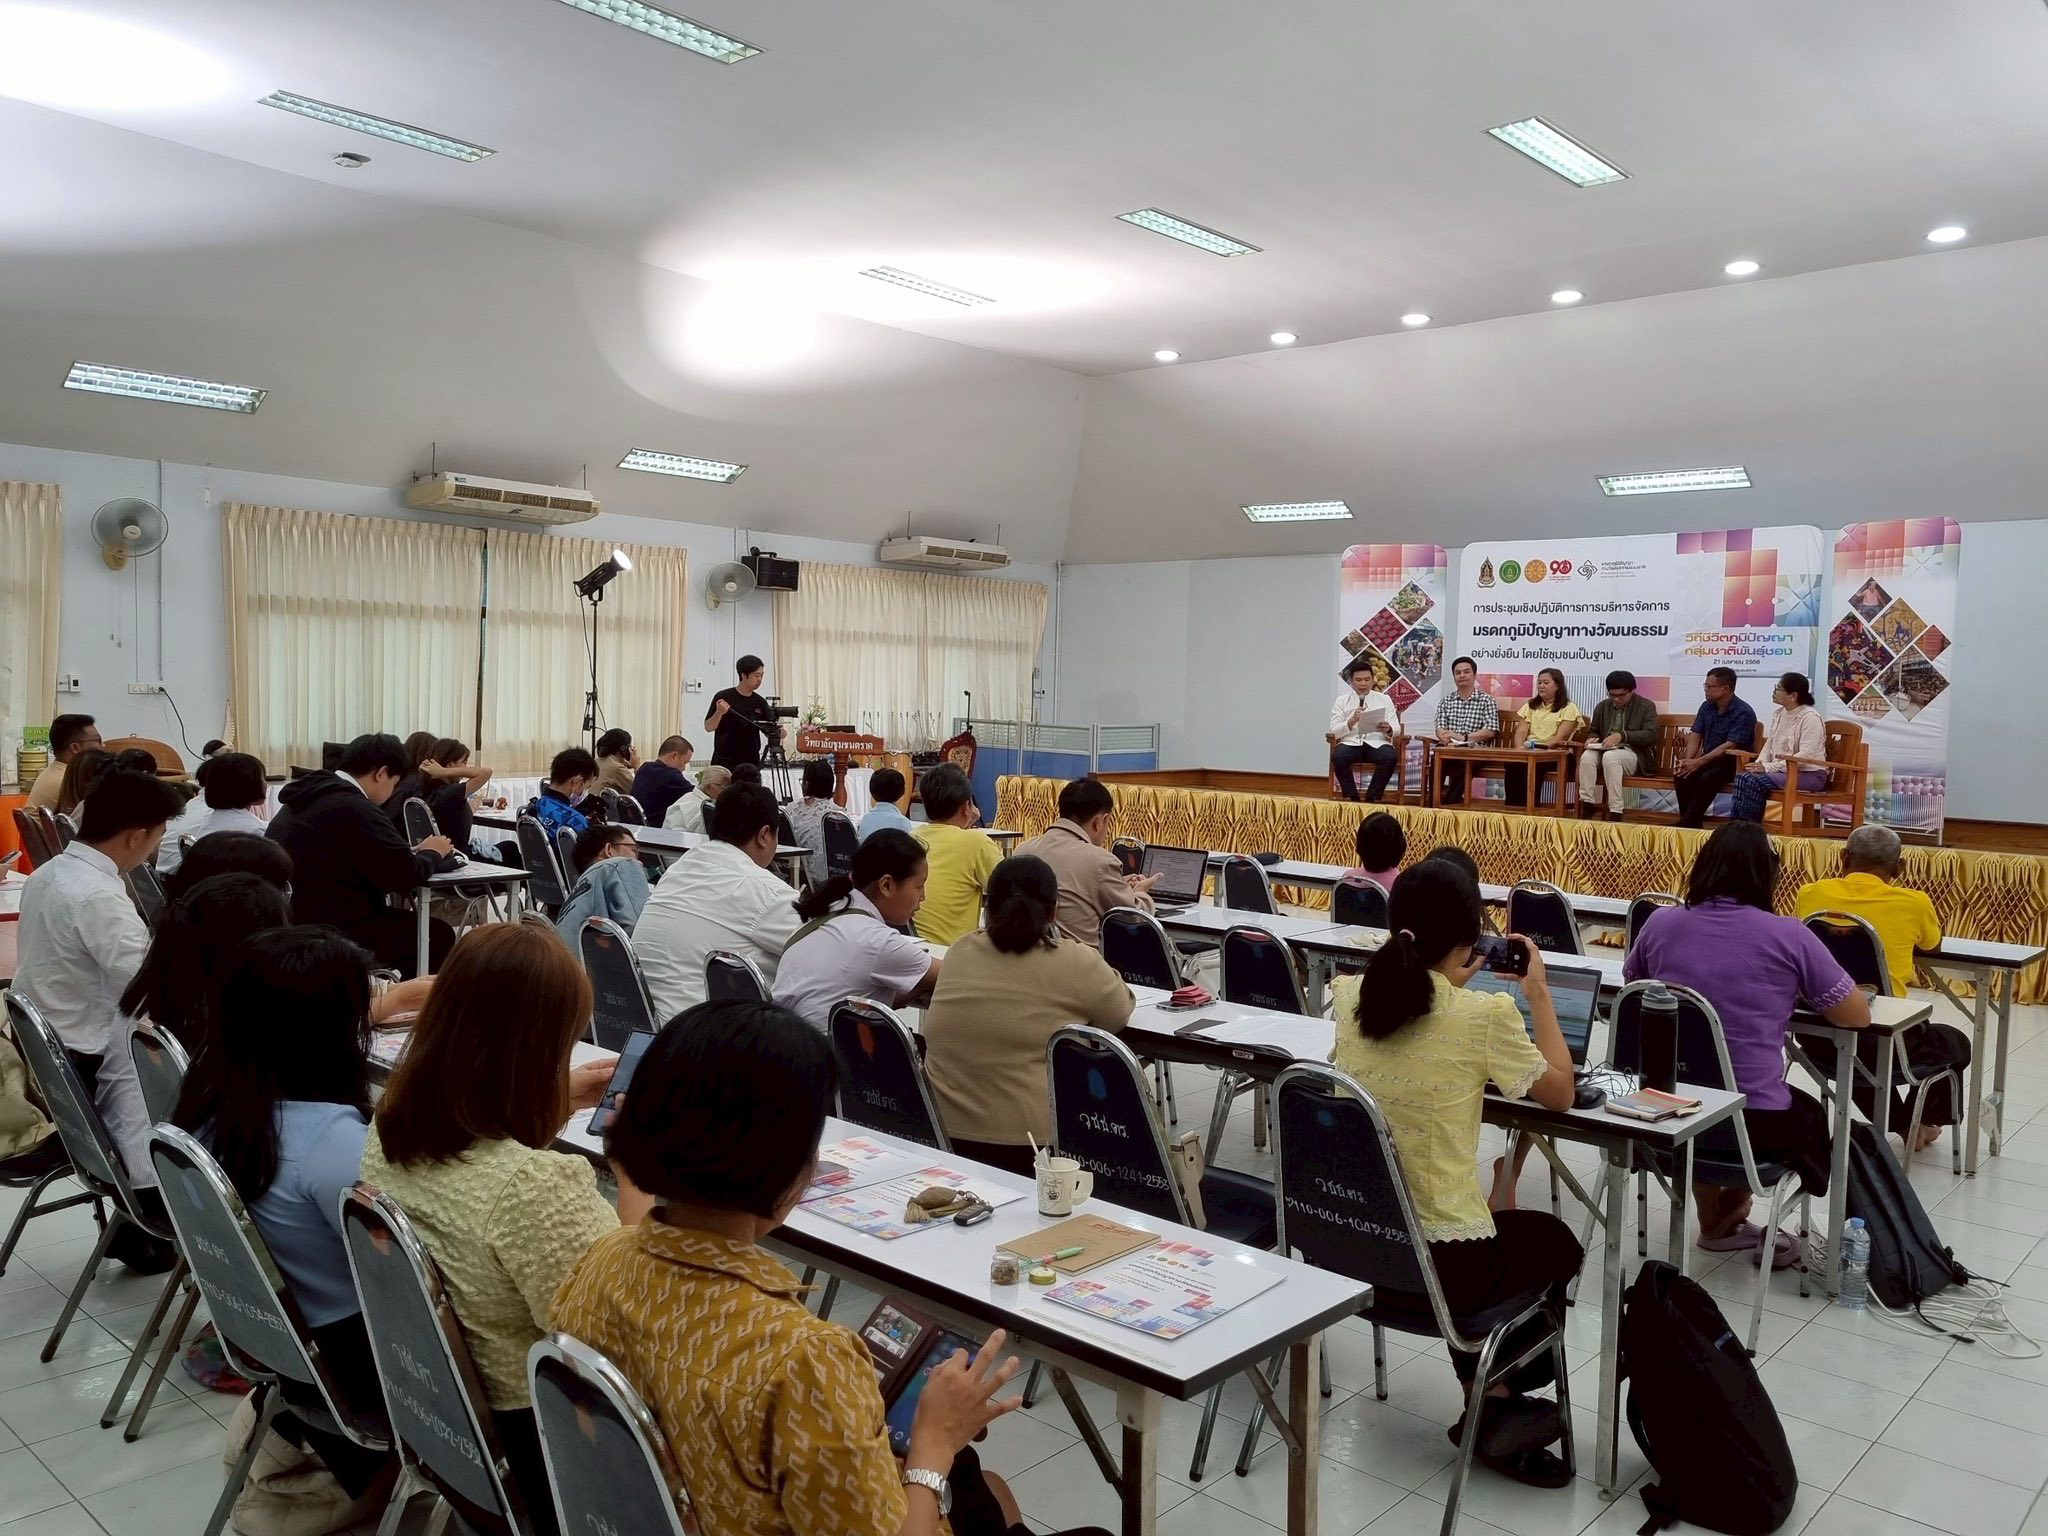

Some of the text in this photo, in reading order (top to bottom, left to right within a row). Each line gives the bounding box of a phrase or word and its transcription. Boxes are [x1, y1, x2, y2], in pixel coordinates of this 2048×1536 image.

[1473, 600, 1670, 616] การประชุมเชิงปฏิบัติการการบริหารจัดการ
[1472, 622, 1669, 641] มรดกภูมิปัญญาทางวัฒนธรรม
[1471, 645, 1614, 662] อย่างยั่งยืน โดยใช้ชุมชนเป็นฐาน
[1684, 645, 1793, 658] กลุ่มชาติพันธุ์ชอง
[804, 736, 873, 751] วิทยาลัยชุมชนตราด
